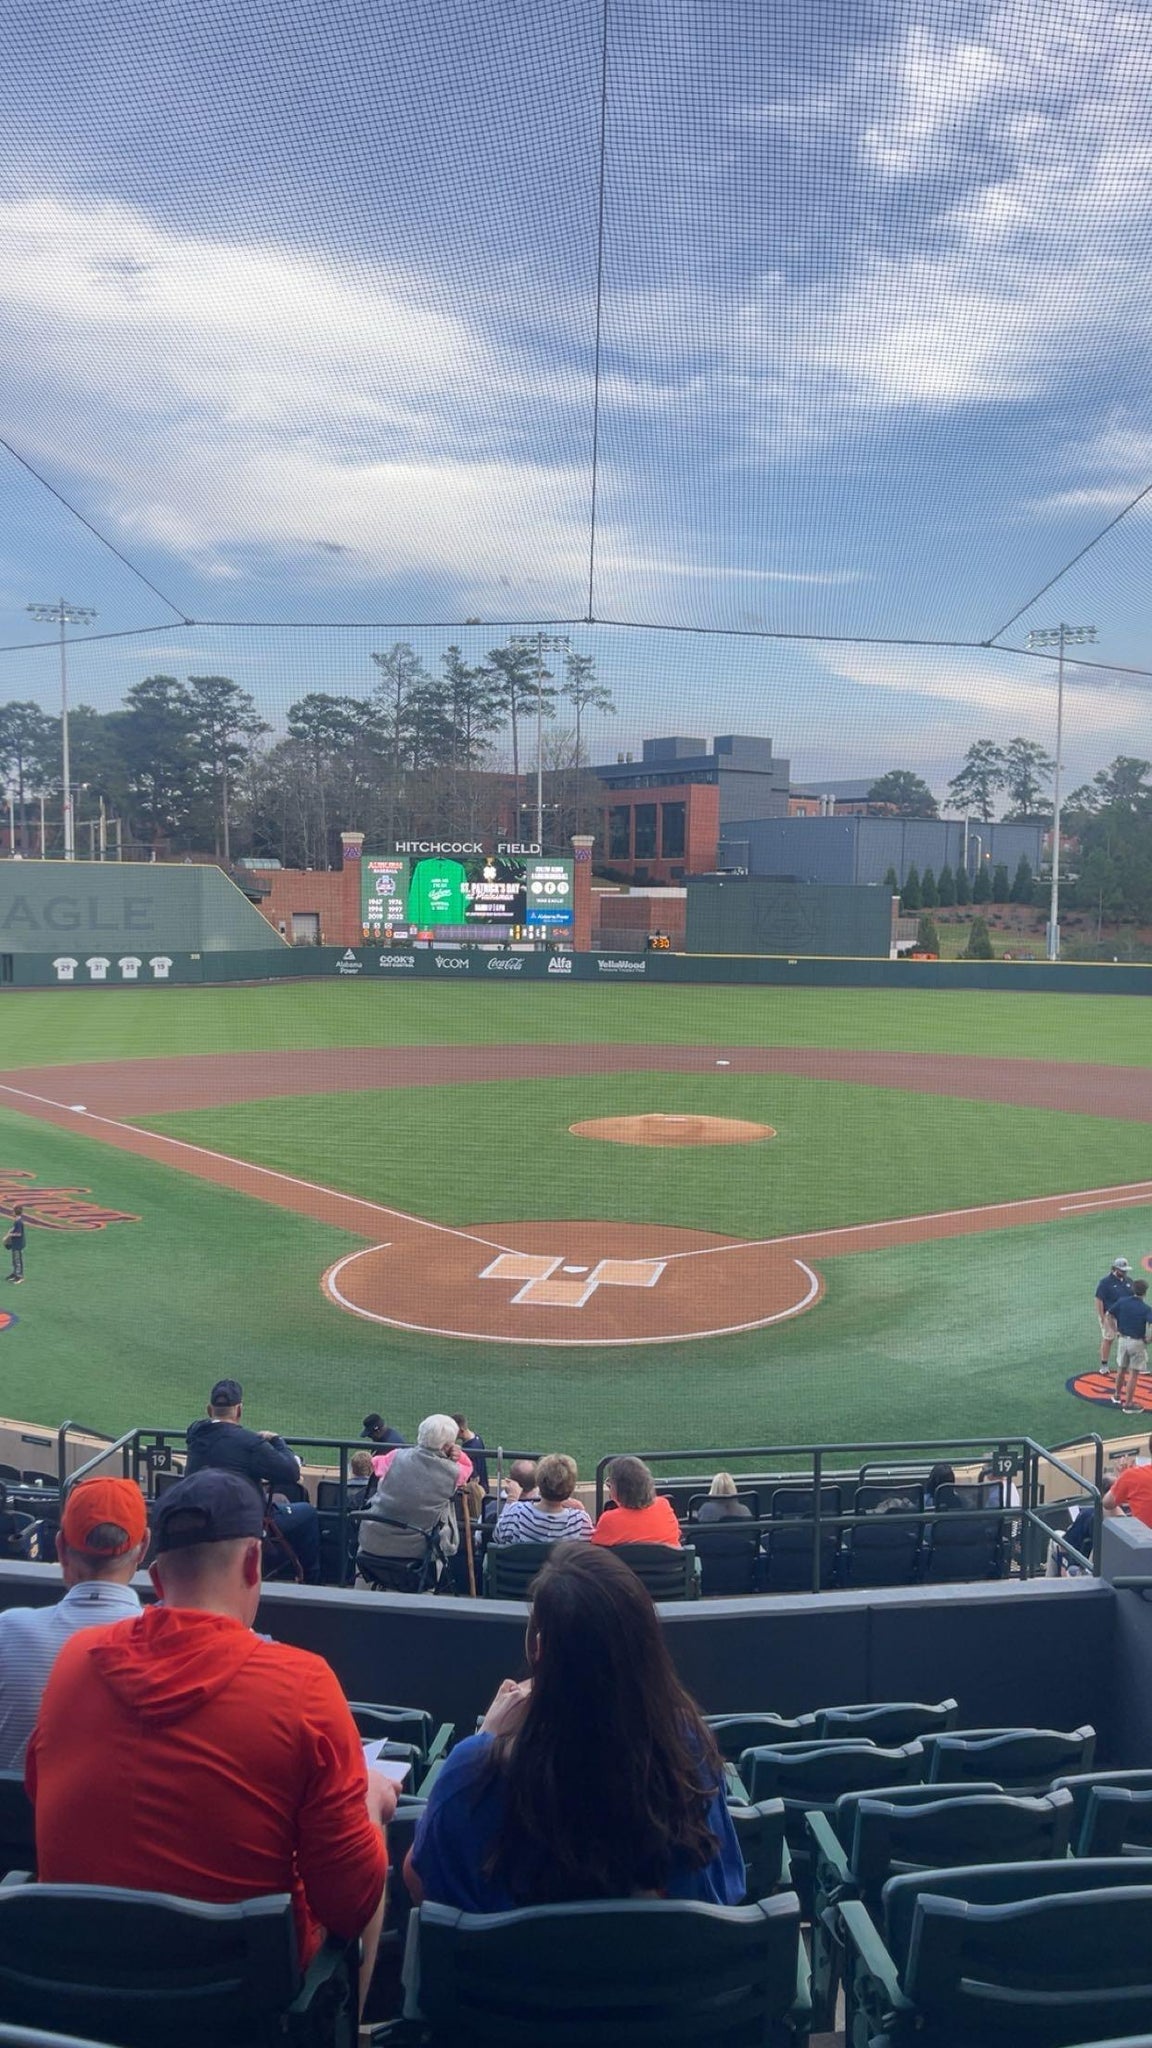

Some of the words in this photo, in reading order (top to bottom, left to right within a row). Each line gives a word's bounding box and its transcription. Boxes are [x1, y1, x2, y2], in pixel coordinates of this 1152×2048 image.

[395, 841, 483, 853] HITCHCOCK
[497, 843, 541, 854] FIELD
[506, 883, 520, 894] DAY
[380, 955, 415, 963] COOK'S
[435, 955, 469, 968] VCOM
[548, 957, 572, 969] Alfa
[597, 960, 646, 968] YellaWood
[152, 1454, 166, 1466] 19
[998, 1460, 1012, 1472] 19
